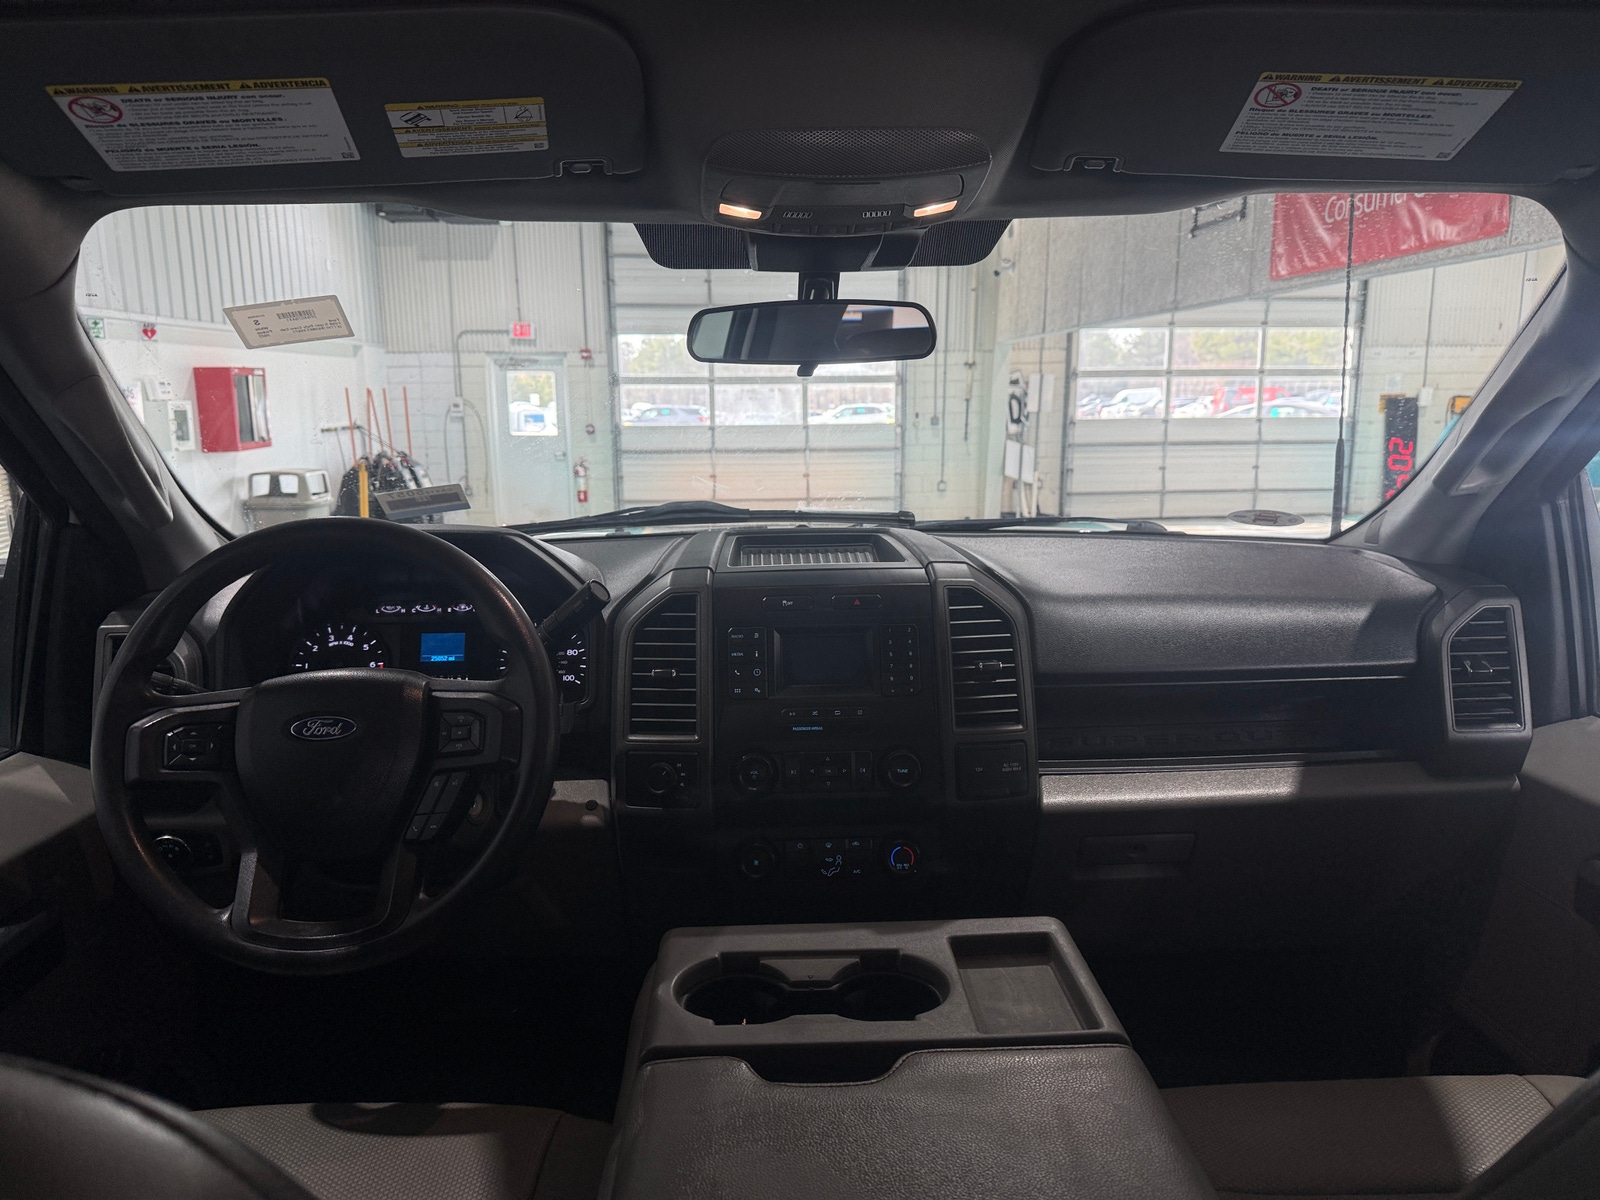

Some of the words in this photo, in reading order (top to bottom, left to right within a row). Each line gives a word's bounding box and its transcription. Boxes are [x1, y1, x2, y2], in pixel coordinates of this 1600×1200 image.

[1274, 74, 1322, 82] WARNING
[1341, 76, 1427, 85] AVERTISSEMENT
[141, 82, 231, 92] AVERTISSEMENT
[253, 80, 328, 89] ADVERTENCIA
[1446, 79, 1520, 89] ADVERTENCIA
[67, 86, 119, 94] WARNING
[562, 674, 575, 682] 100
[303, 719, 343, 736] Ford
